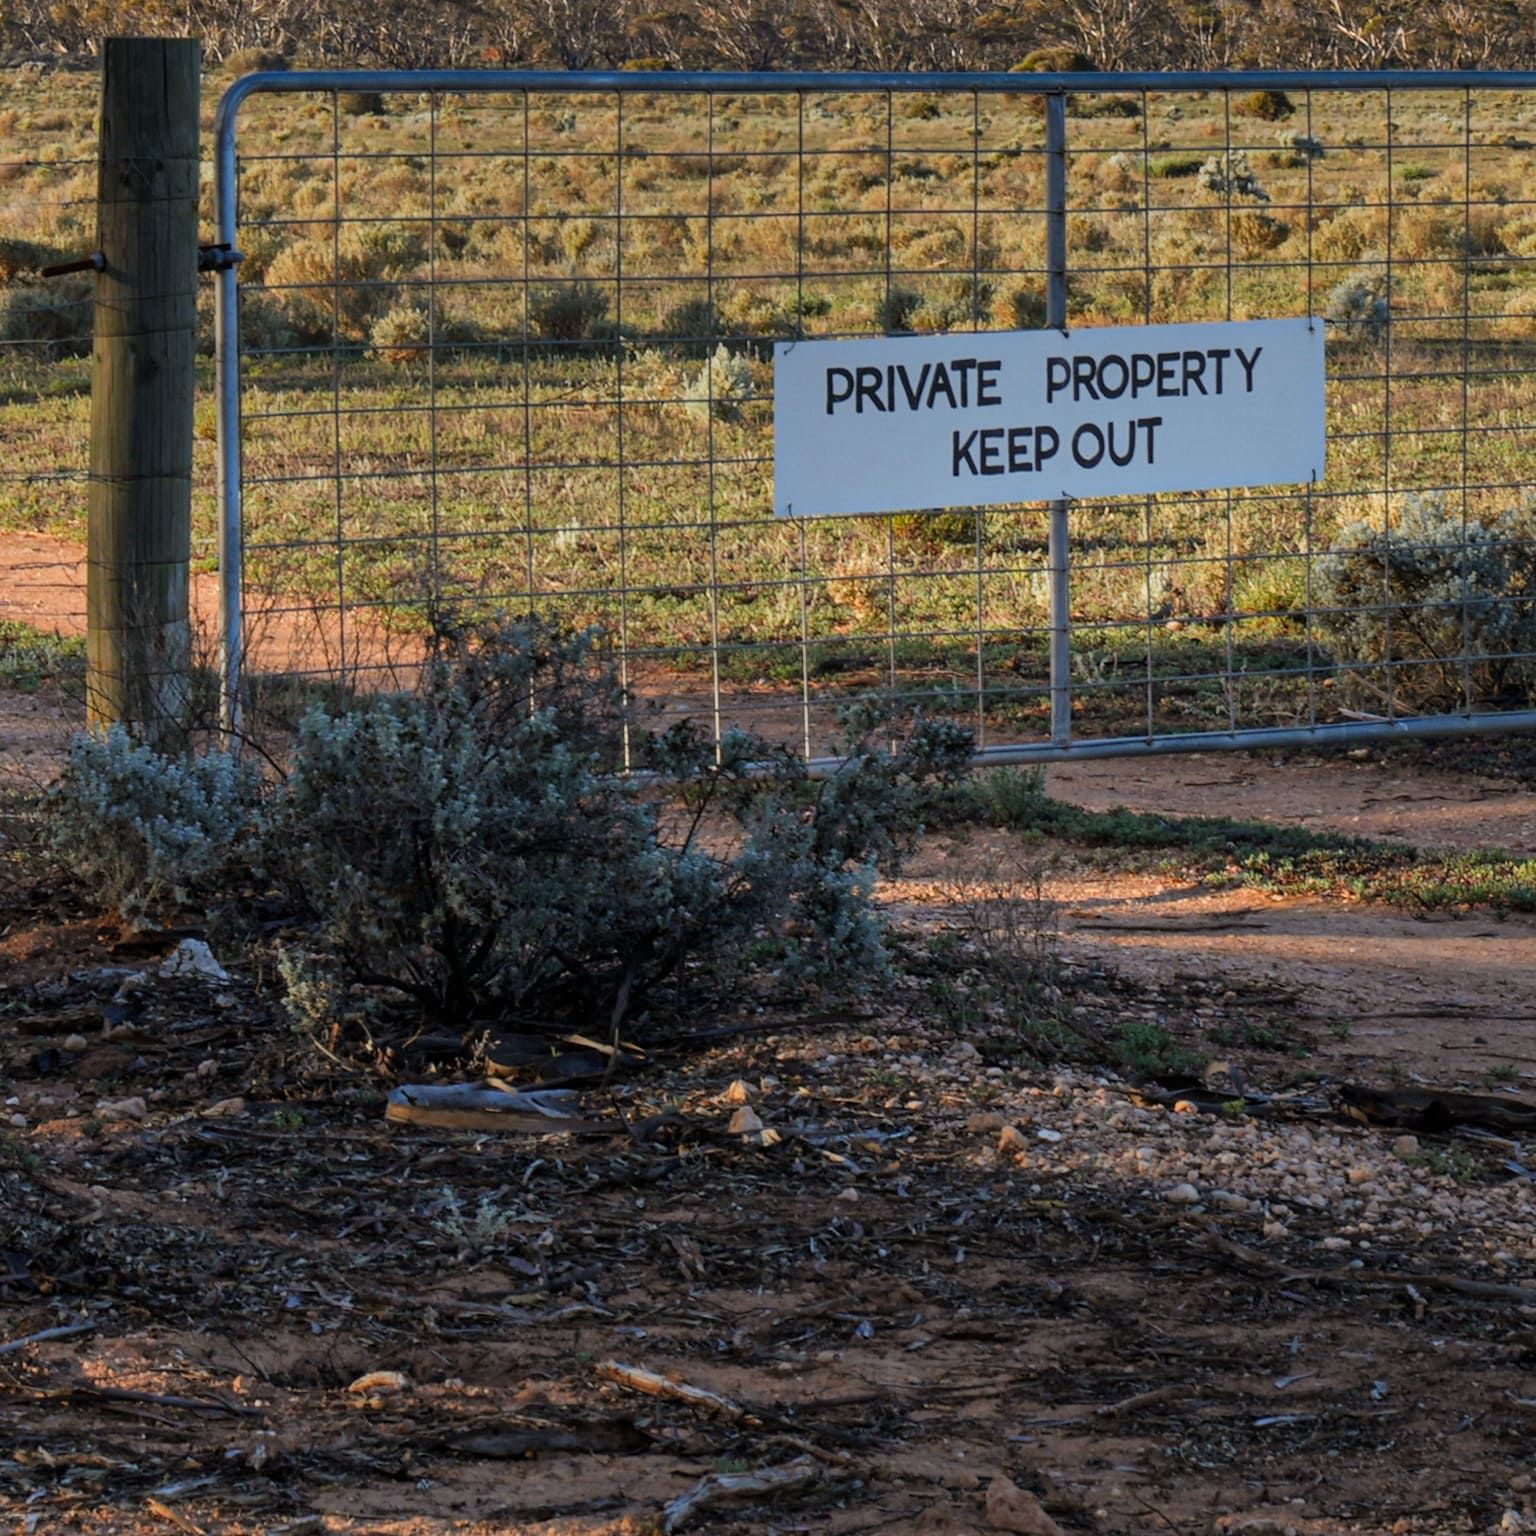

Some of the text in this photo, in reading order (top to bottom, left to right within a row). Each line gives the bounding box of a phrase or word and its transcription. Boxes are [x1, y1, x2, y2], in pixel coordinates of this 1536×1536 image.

[826, 347, 1262, 415] PRIVATE PROPERTY
[953, 417, 1162, 476] KEEP OUT
